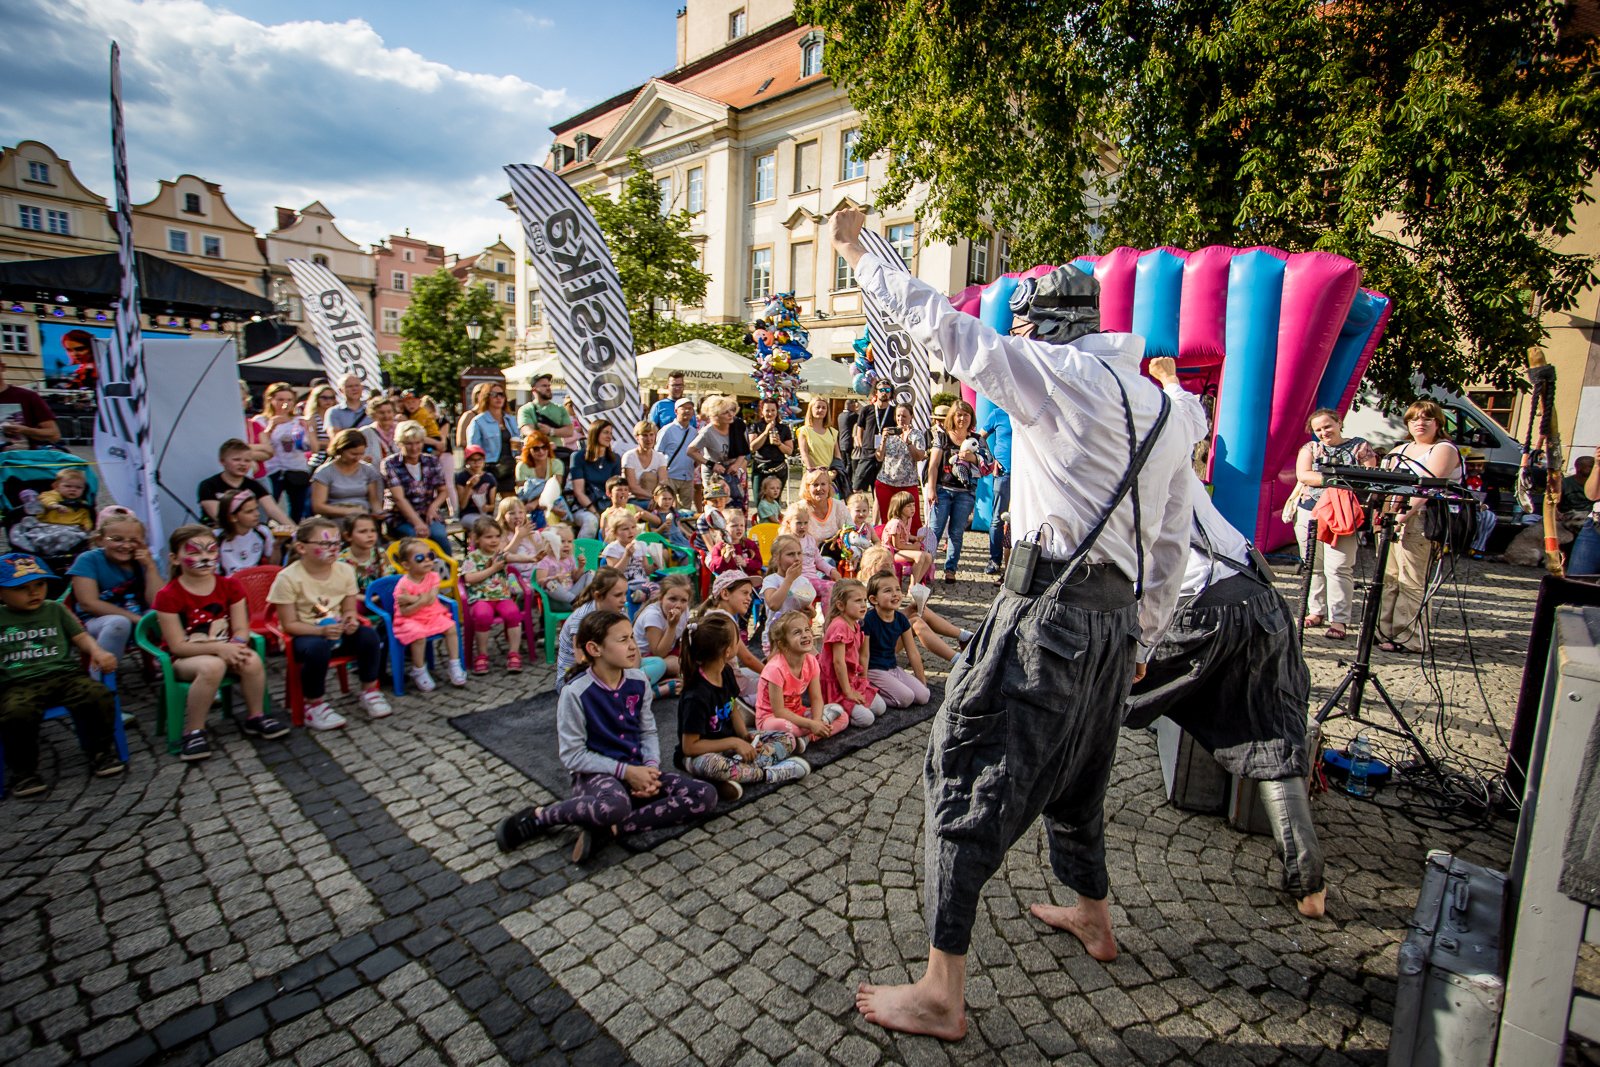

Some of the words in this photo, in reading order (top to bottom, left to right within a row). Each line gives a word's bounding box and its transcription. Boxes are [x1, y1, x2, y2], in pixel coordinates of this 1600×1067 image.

[681, 370, 723, 380] WNICZKA
[0, 627, 58, 643] HIDDEN
[3, 646, 59, 663] JUNGLE
